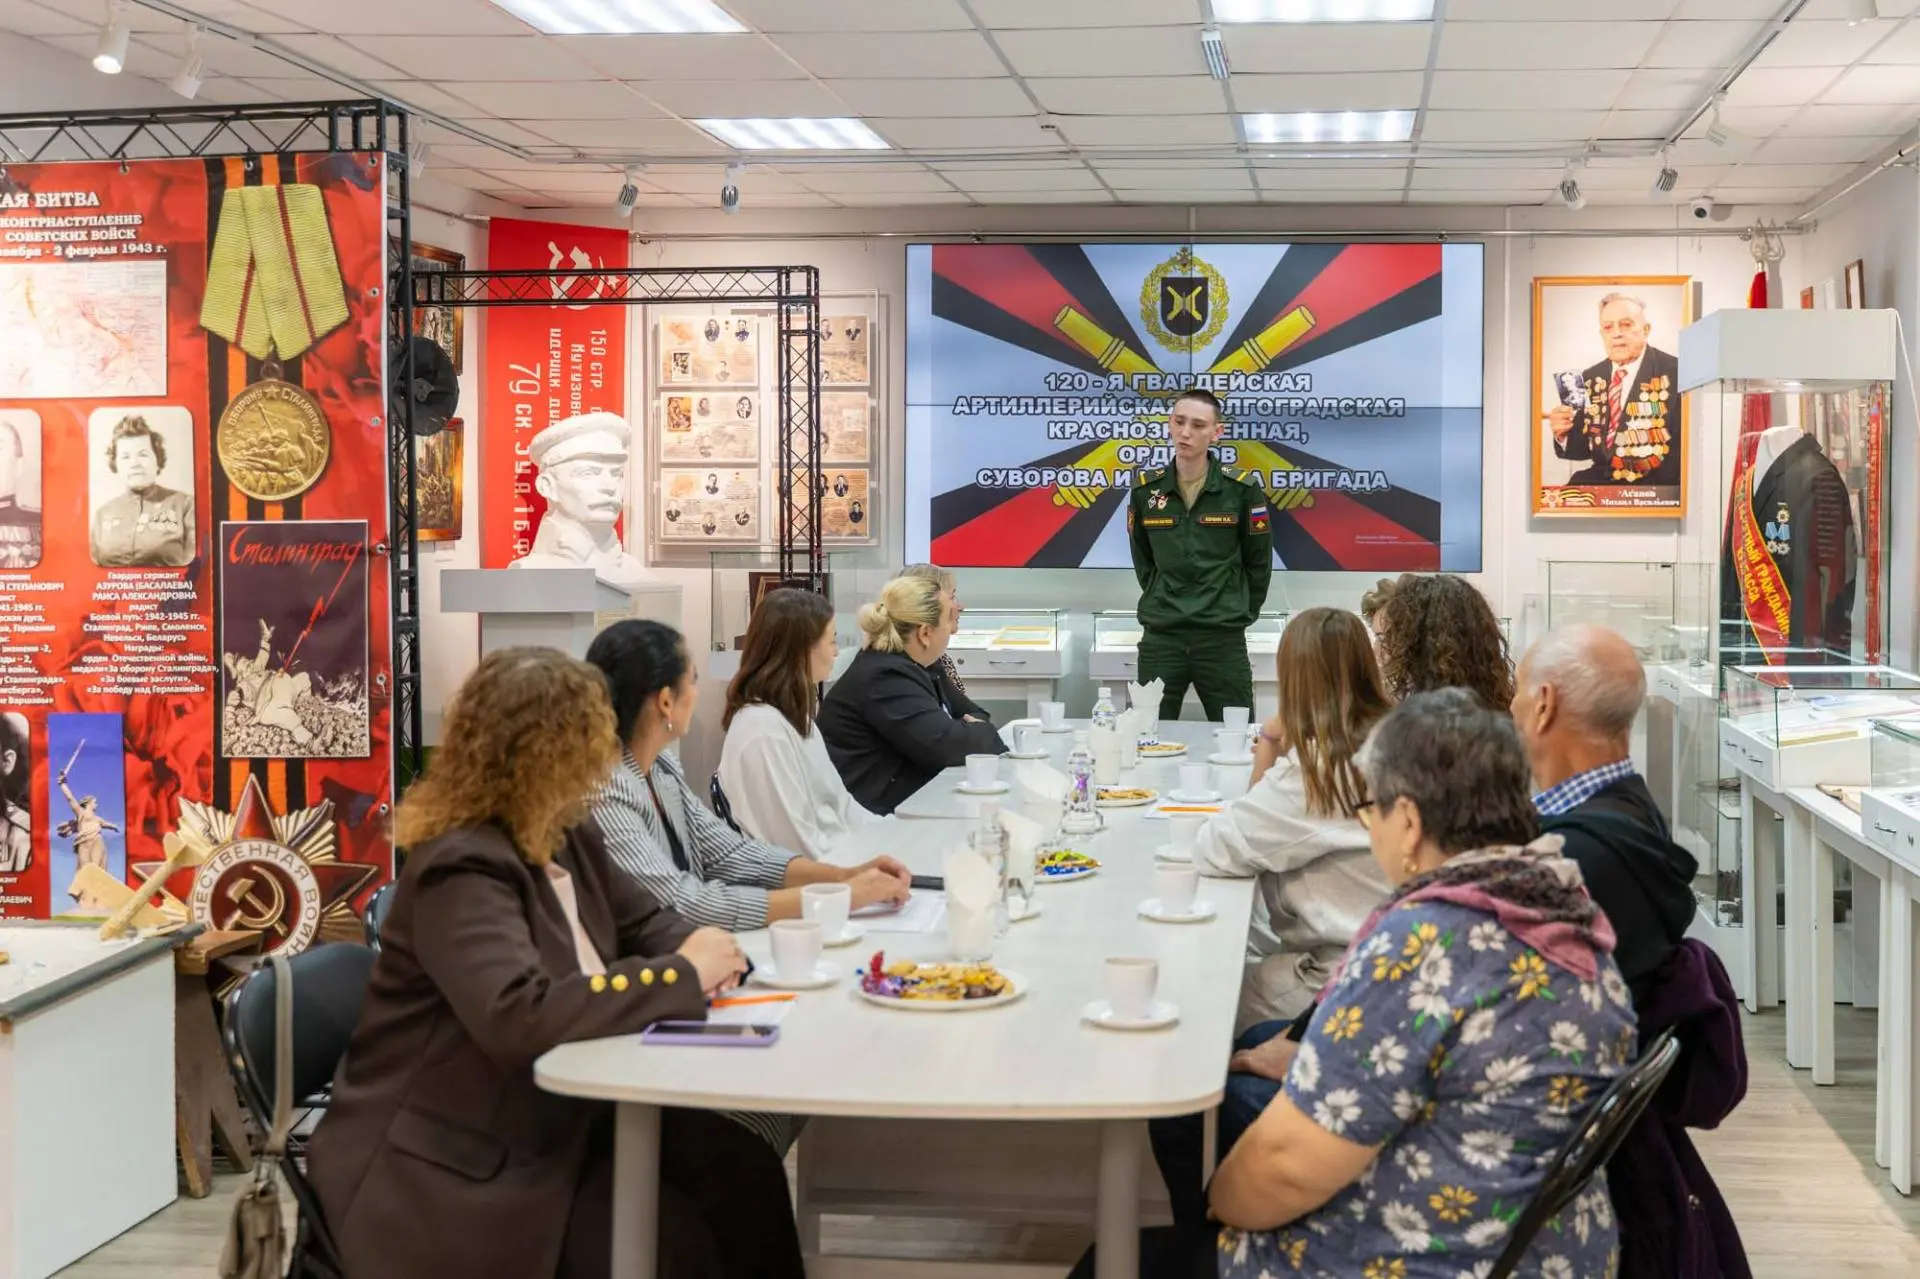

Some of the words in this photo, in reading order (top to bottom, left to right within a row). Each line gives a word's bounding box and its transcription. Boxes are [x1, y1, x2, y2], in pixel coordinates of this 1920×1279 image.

[35, 192, 100, 208] БИТВА
[5, 231, 89, 243] СОВЕТСКИХ
[91, 227, 137, 241] ВОЙСК
[53, 245, 63, 257] 2
[65, 243, 118, 259] февраля
[122, 243, 153, 254] 1943
[156, 245, 168, 253] г.
[590, 329, 607, 356] 150
[508, 362, 541, 395] 79
[590, 362, 603, 393] СТР.
[1045, 373, 1088, 391] 120
[1106, 373, 1125, 391] Я
[1132, 371, 1312, 392] ГВАРДЕЙСКАЯ
[976, 468, 1108, 489] СУВОРОВА
[1114, 469, 1131, 488] И
[1271, 469, 1390, 492] БРИГАДА
[229, 526, 364, 574] Сталинград
[92, 592, 120, 601] РАИСА
[121, 591, 198, 601] АЛЕКСАНДРОВНА
[90, 612, 121, 621] Боевой
[145, 612, 188, 621] 1942-1945
